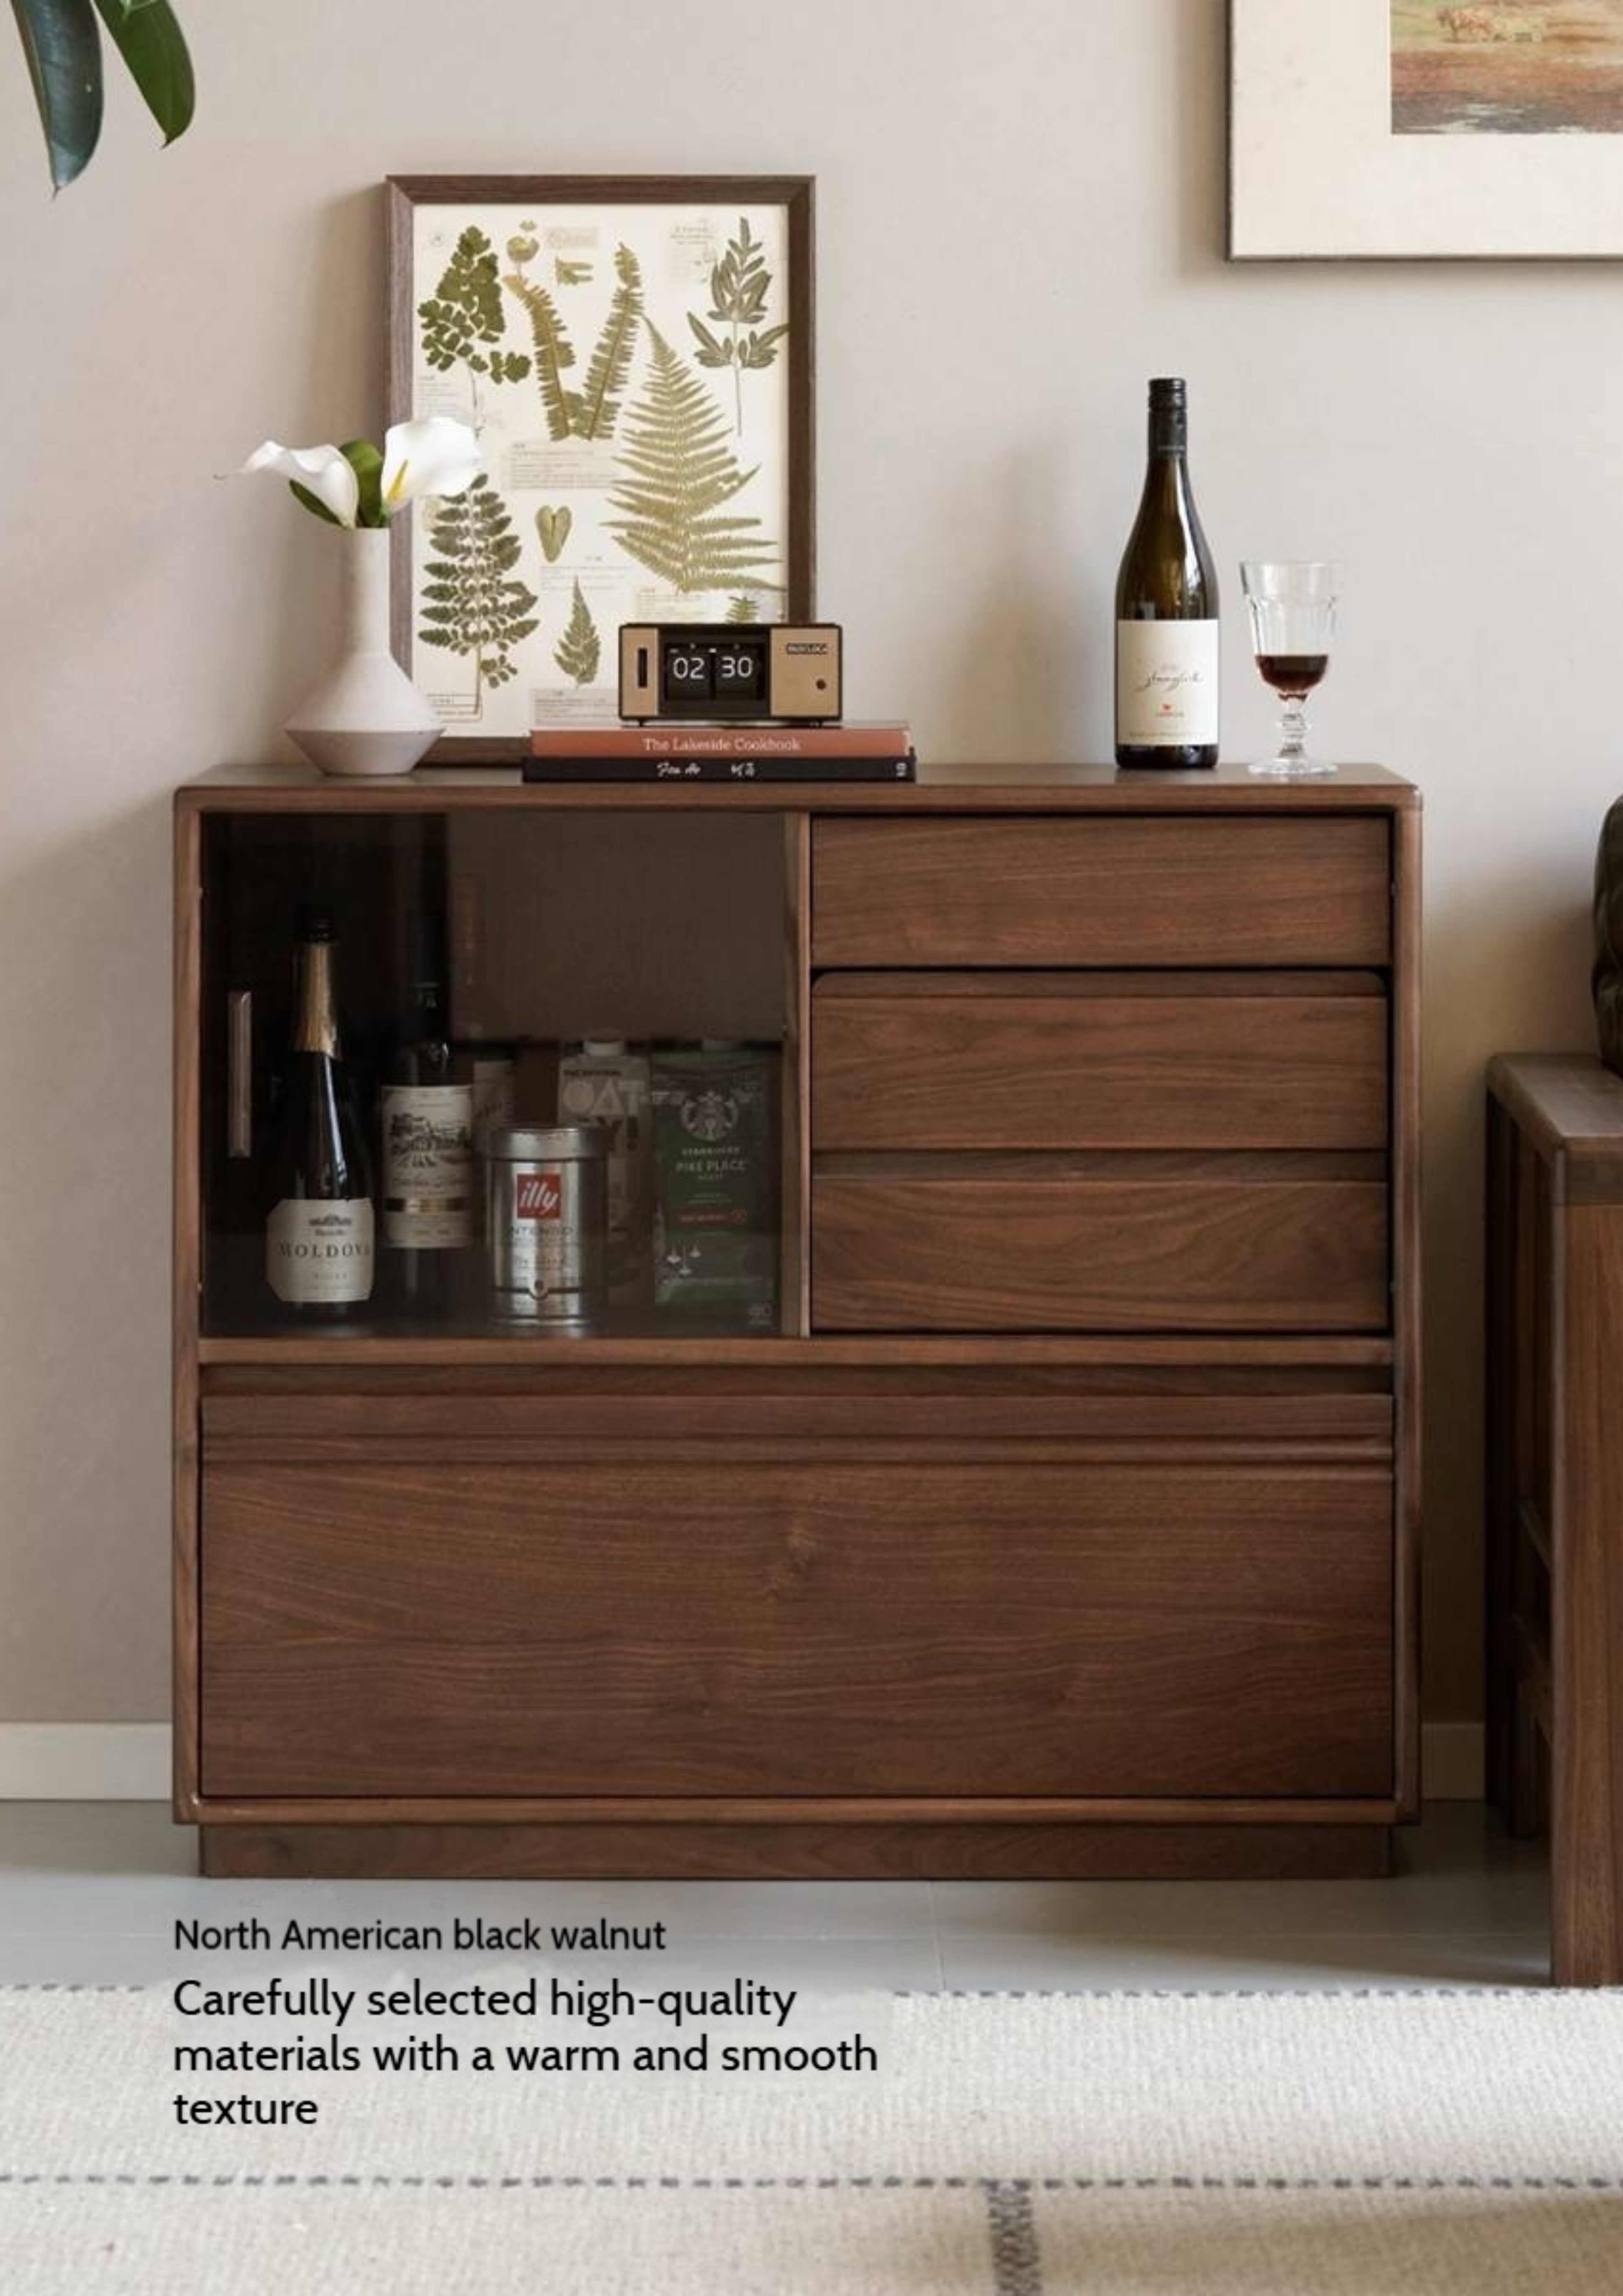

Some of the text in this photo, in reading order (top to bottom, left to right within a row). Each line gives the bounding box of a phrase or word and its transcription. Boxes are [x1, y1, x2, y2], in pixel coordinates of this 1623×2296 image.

[673, 656, 753, 679] 02 30
[643, 736, 801, 751] The Lakeside Cookbook
[706, 1159, 746, 1172] PLACE
[519, 1181, 559, 1215] illy
